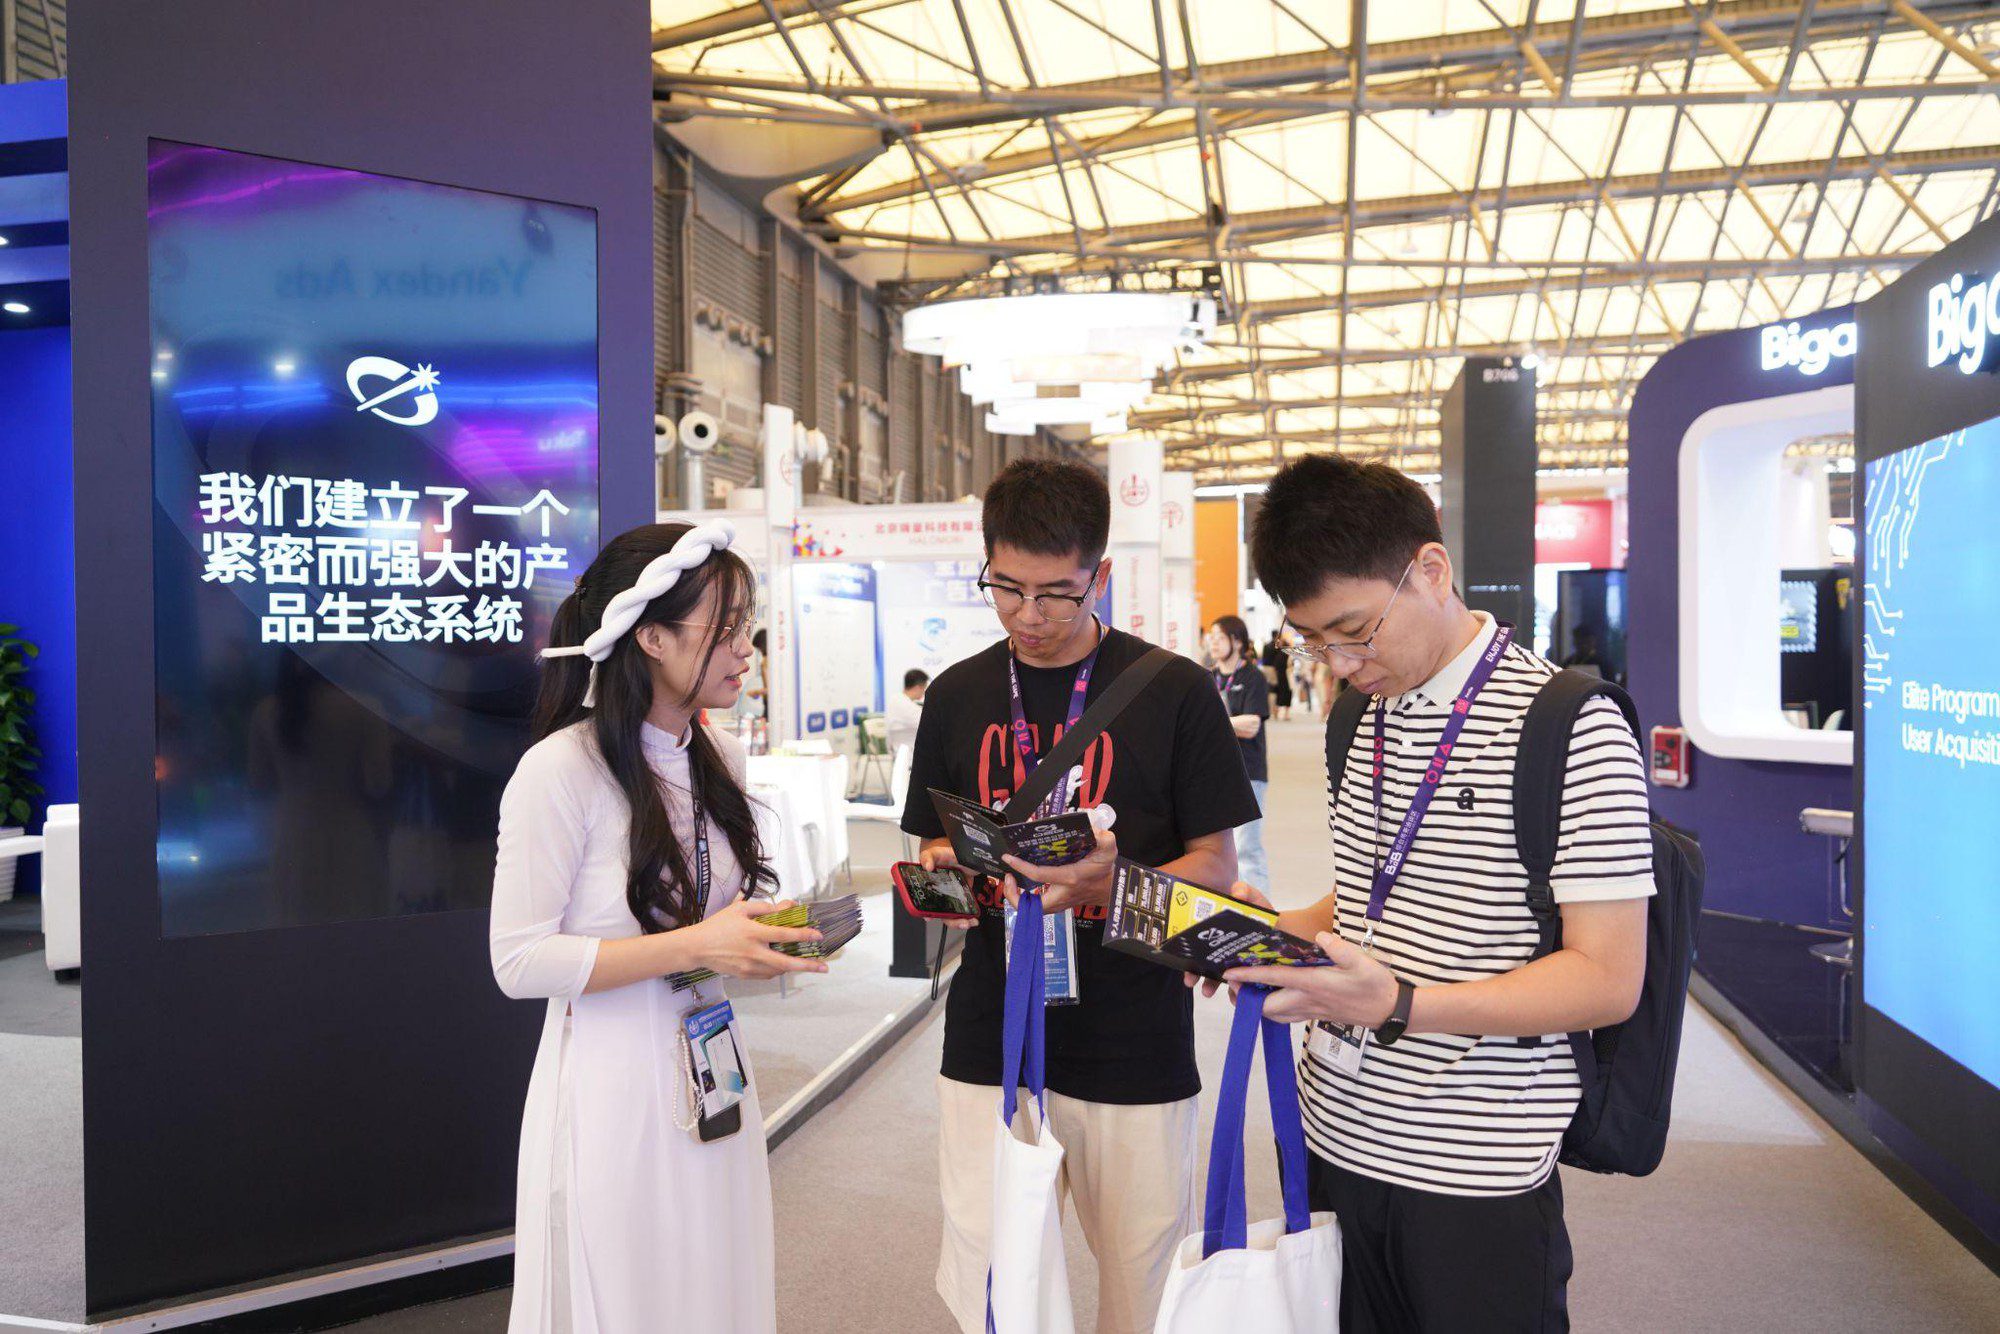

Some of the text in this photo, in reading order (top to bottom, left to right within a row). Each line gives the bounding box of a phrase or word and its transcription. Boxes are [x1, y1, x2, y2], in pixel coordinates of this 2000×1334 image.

[198, 472, 571, 537] 我们建立了一个
[200, 529, 570, 589] 紧密而强大的产
[261, 592, 524, 644] 品生态系统
[1901, 722, 1933, 754] User
[1456, 787, 1476, 811] a
